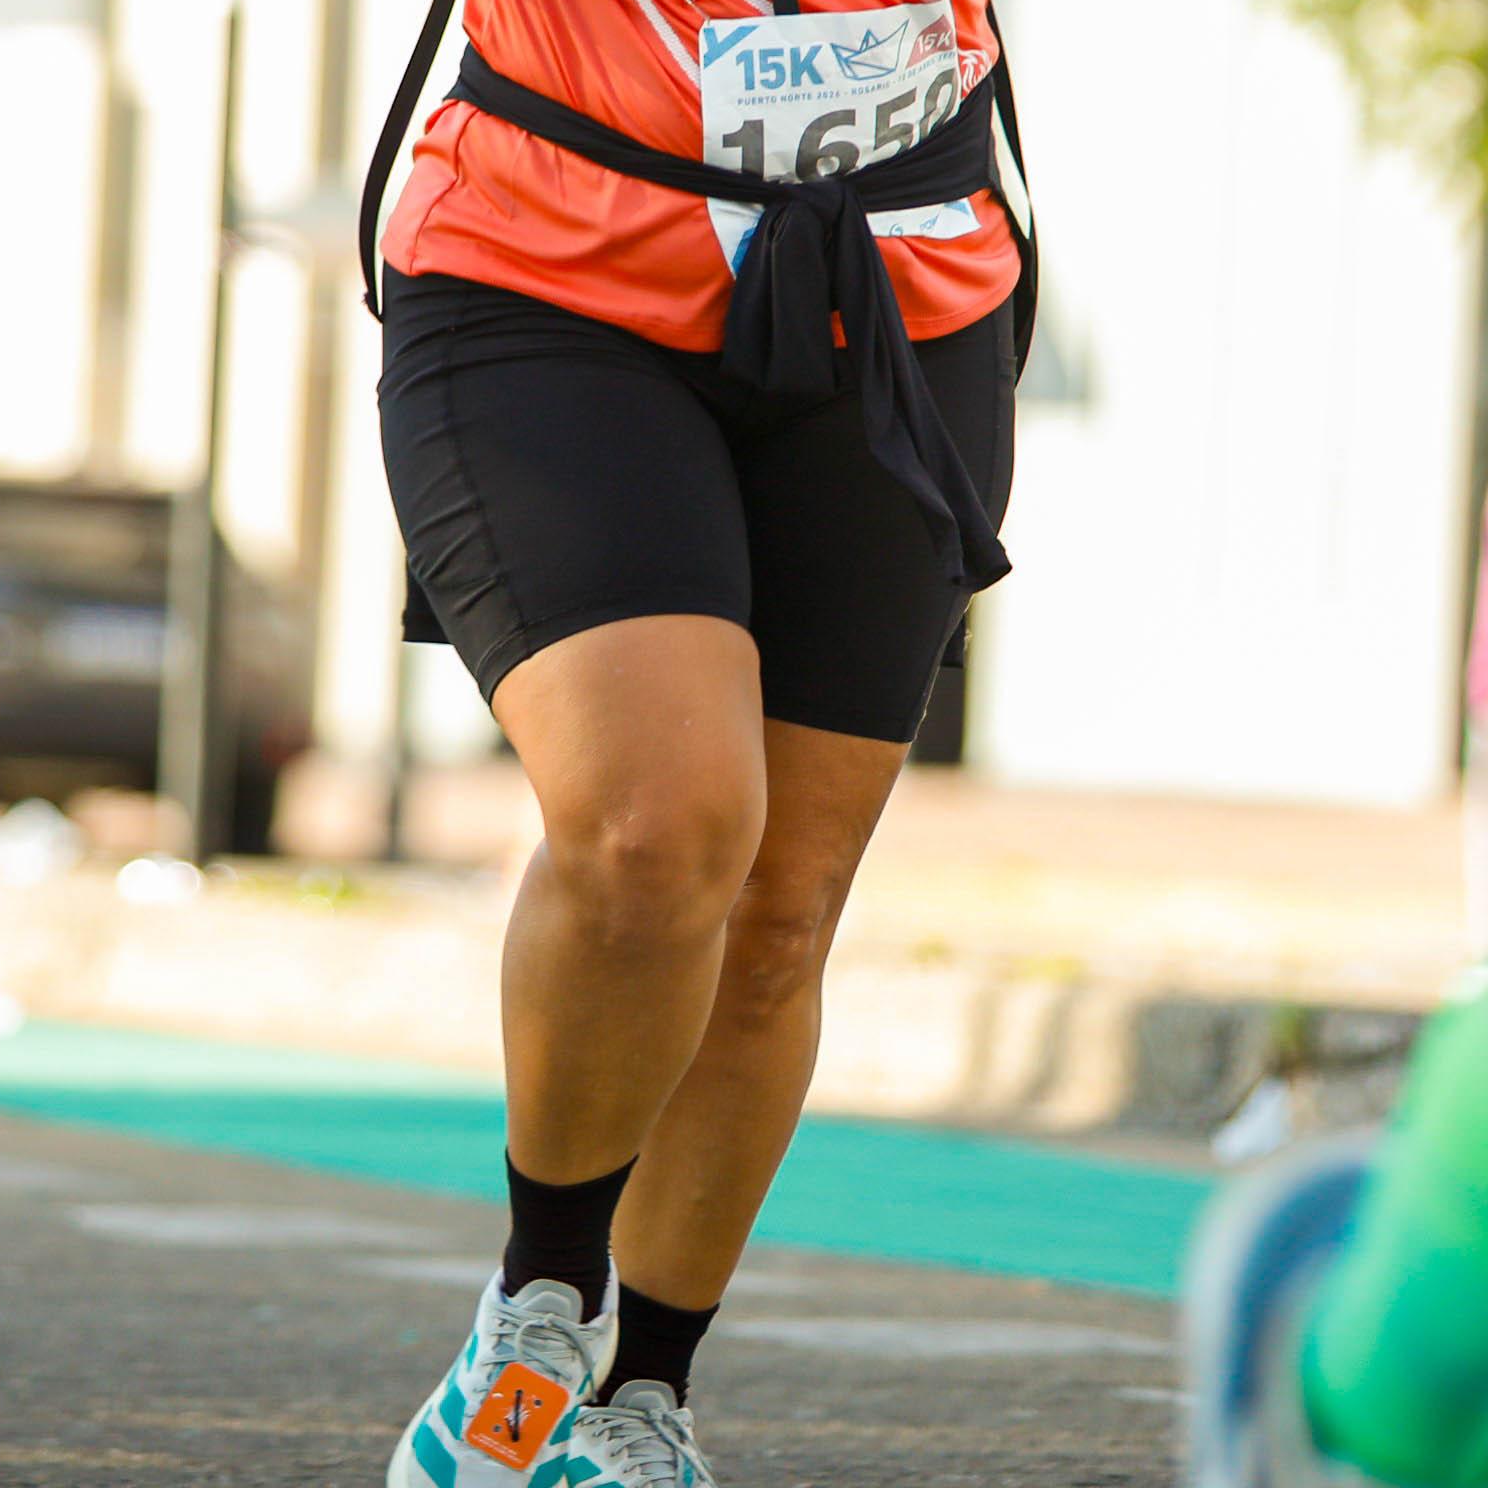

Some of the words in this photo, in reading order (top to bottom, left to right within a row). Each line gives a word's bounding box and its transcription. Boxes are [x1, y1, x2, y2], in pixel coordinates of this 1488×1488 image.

[917, 28, 952, 55] 15K
[735, 45, 824, 91] 15K
[722, 68, 957, 184] 1650
